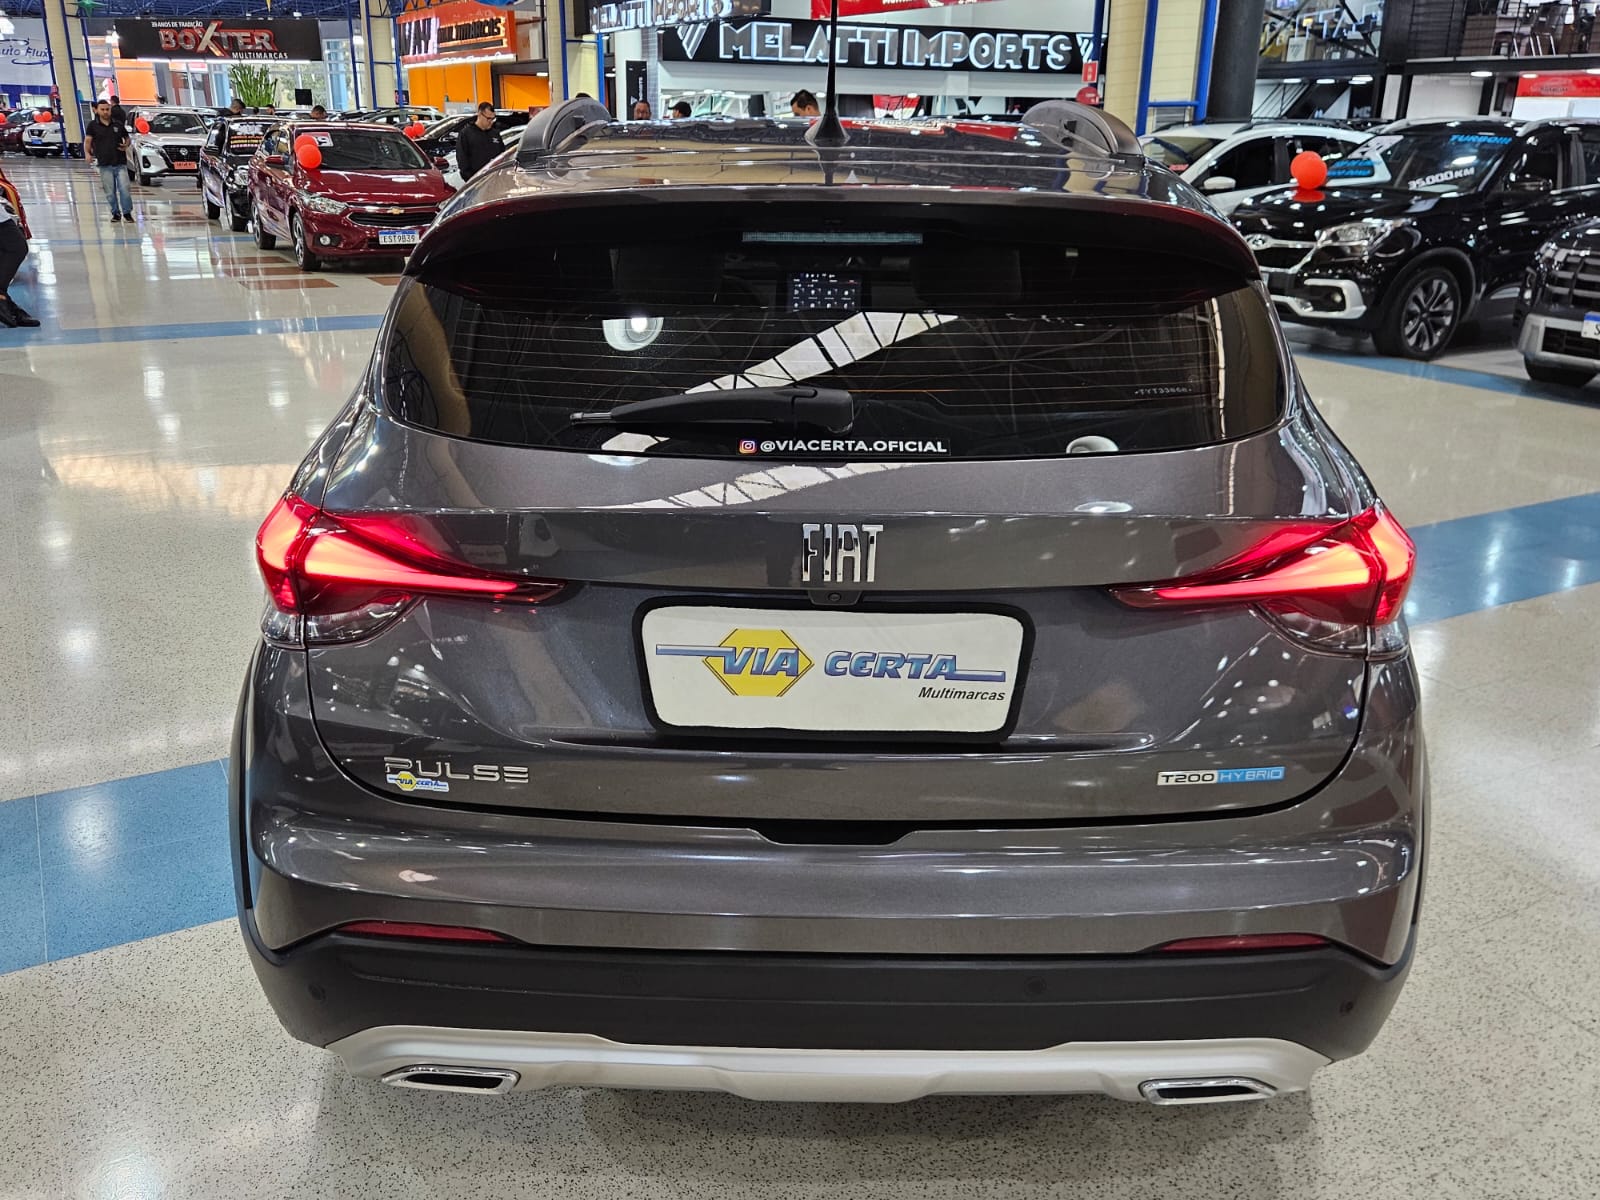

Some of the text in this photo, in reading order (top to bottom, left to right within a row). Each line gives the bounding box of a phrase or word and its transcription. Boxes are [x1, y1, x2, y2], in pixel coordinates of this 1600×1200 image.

[0, 45, 21, 56] uto
[157, 20, 276, 57] BOXTER
[719, 21, 1073, 71] MELATTI IMPORTS
[760, 439, 948, 453] @VIACERTA.OFICIAL
[801, 523, 883, 583] FIAT
[722, 646, 957, 680] VIA CERTA
[917, 686, 1006, 702] Multimarcas
[383, 756, 529, 783] PULSE
[1160, 769, 1284, 784] T200 HYBRID
